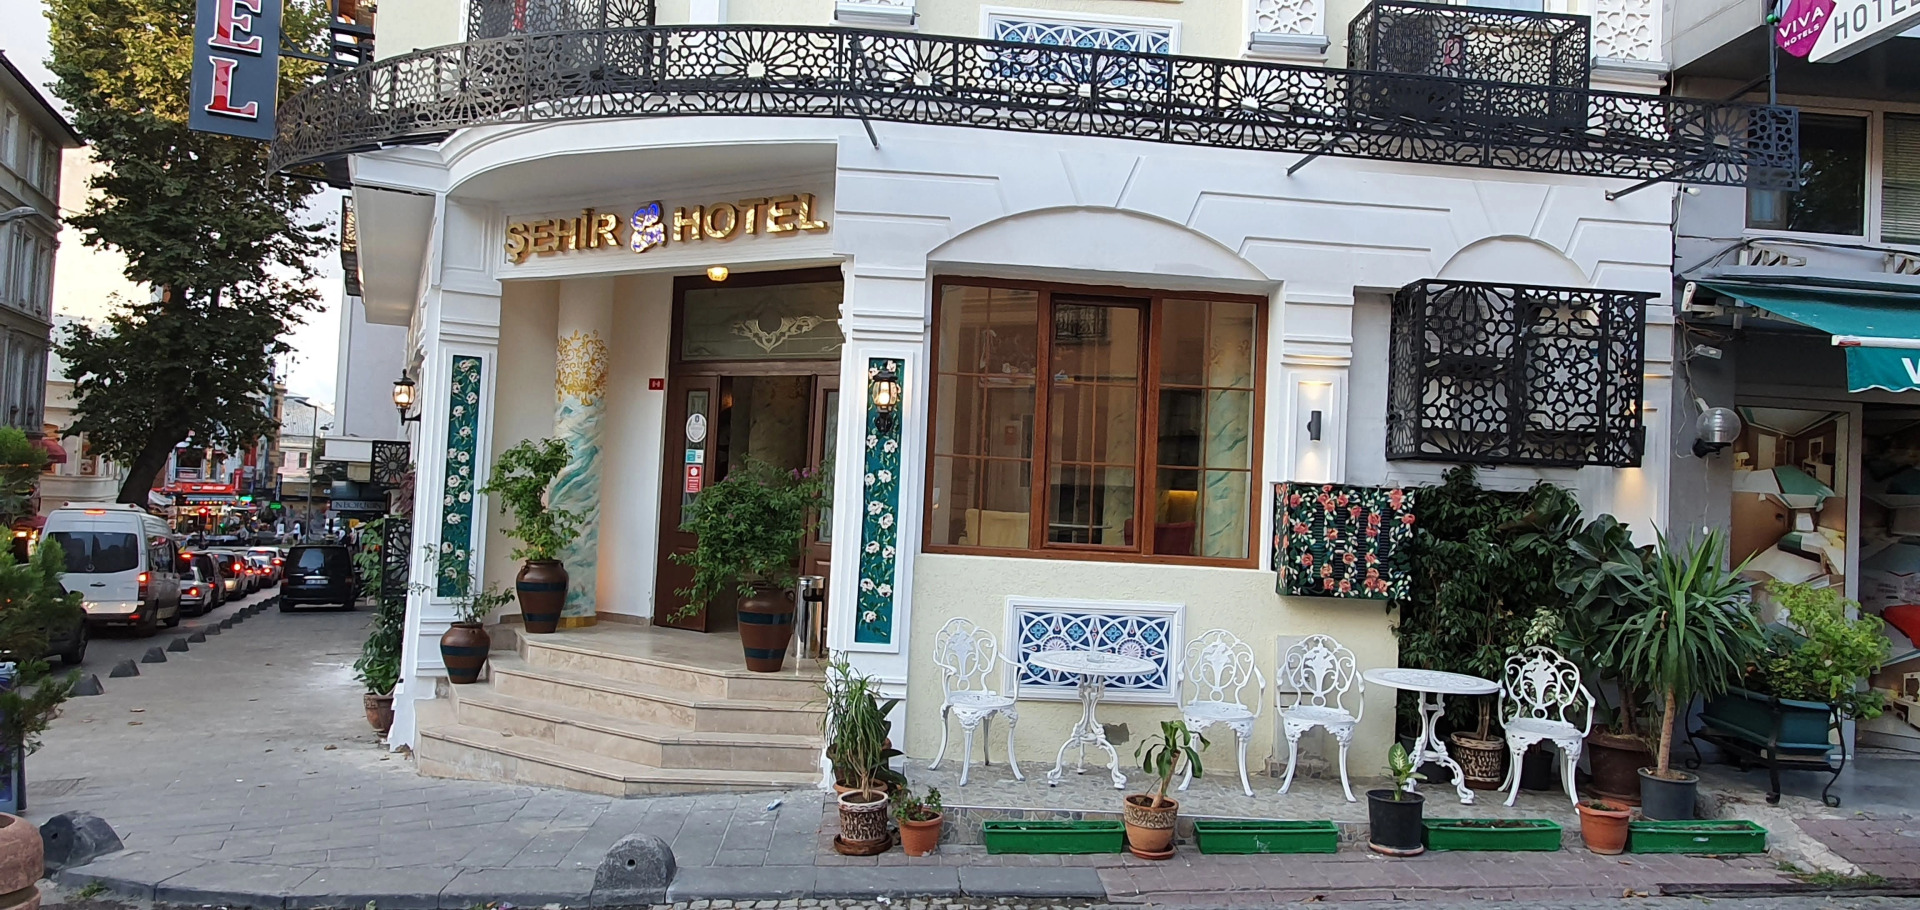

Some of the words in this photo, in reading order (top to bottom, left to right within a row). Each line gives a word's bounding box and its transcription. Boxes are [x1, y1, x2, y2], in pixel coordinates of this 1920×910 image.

[1779, 7, 1824, 38] VIVA
[1784, 23, 1820, 47] HOTELS
[505, 209, 622, 264] ŞEHİR
[673, 192, 828, 241] HOTEL
